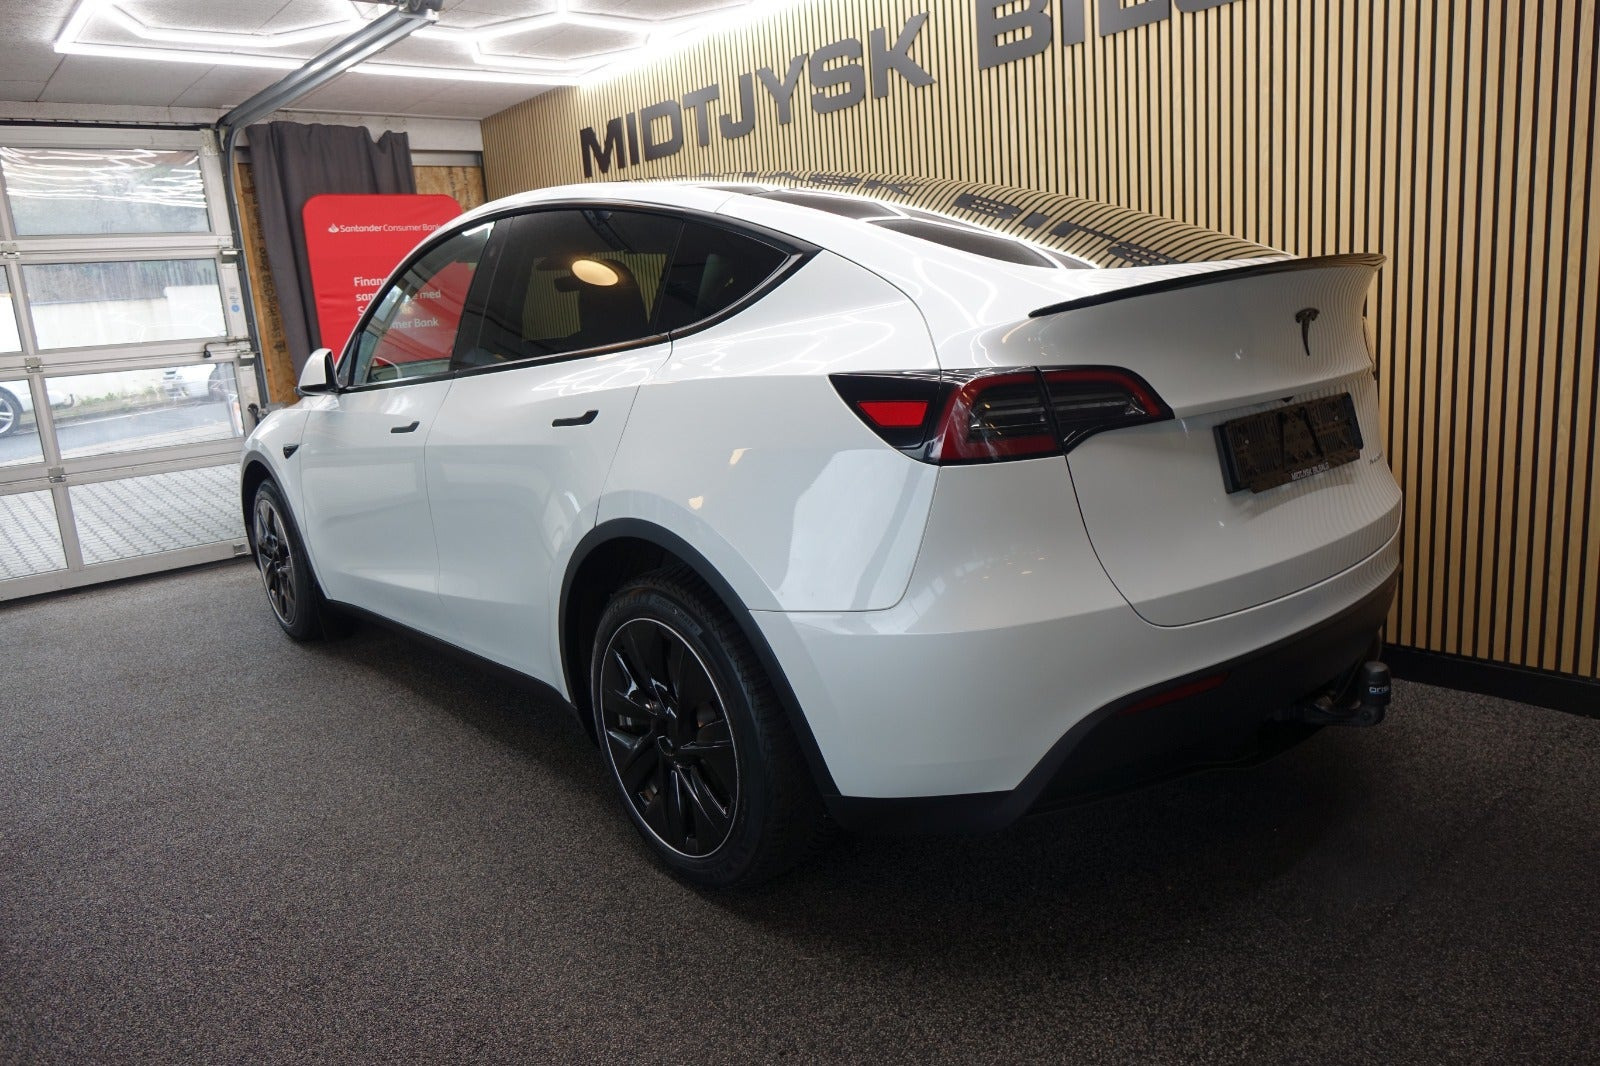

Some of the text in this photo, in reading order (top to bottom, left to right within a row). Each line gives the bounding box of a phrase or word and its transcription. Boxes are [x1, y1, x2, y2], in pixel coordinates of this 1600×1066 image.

[579, 0, 1245, 178] MIDTJYSK BIL
[340, 224, 382, 233] Santander
[383, 224, 421, 232] Consumer
[414, 317, 439, 328] Bank
